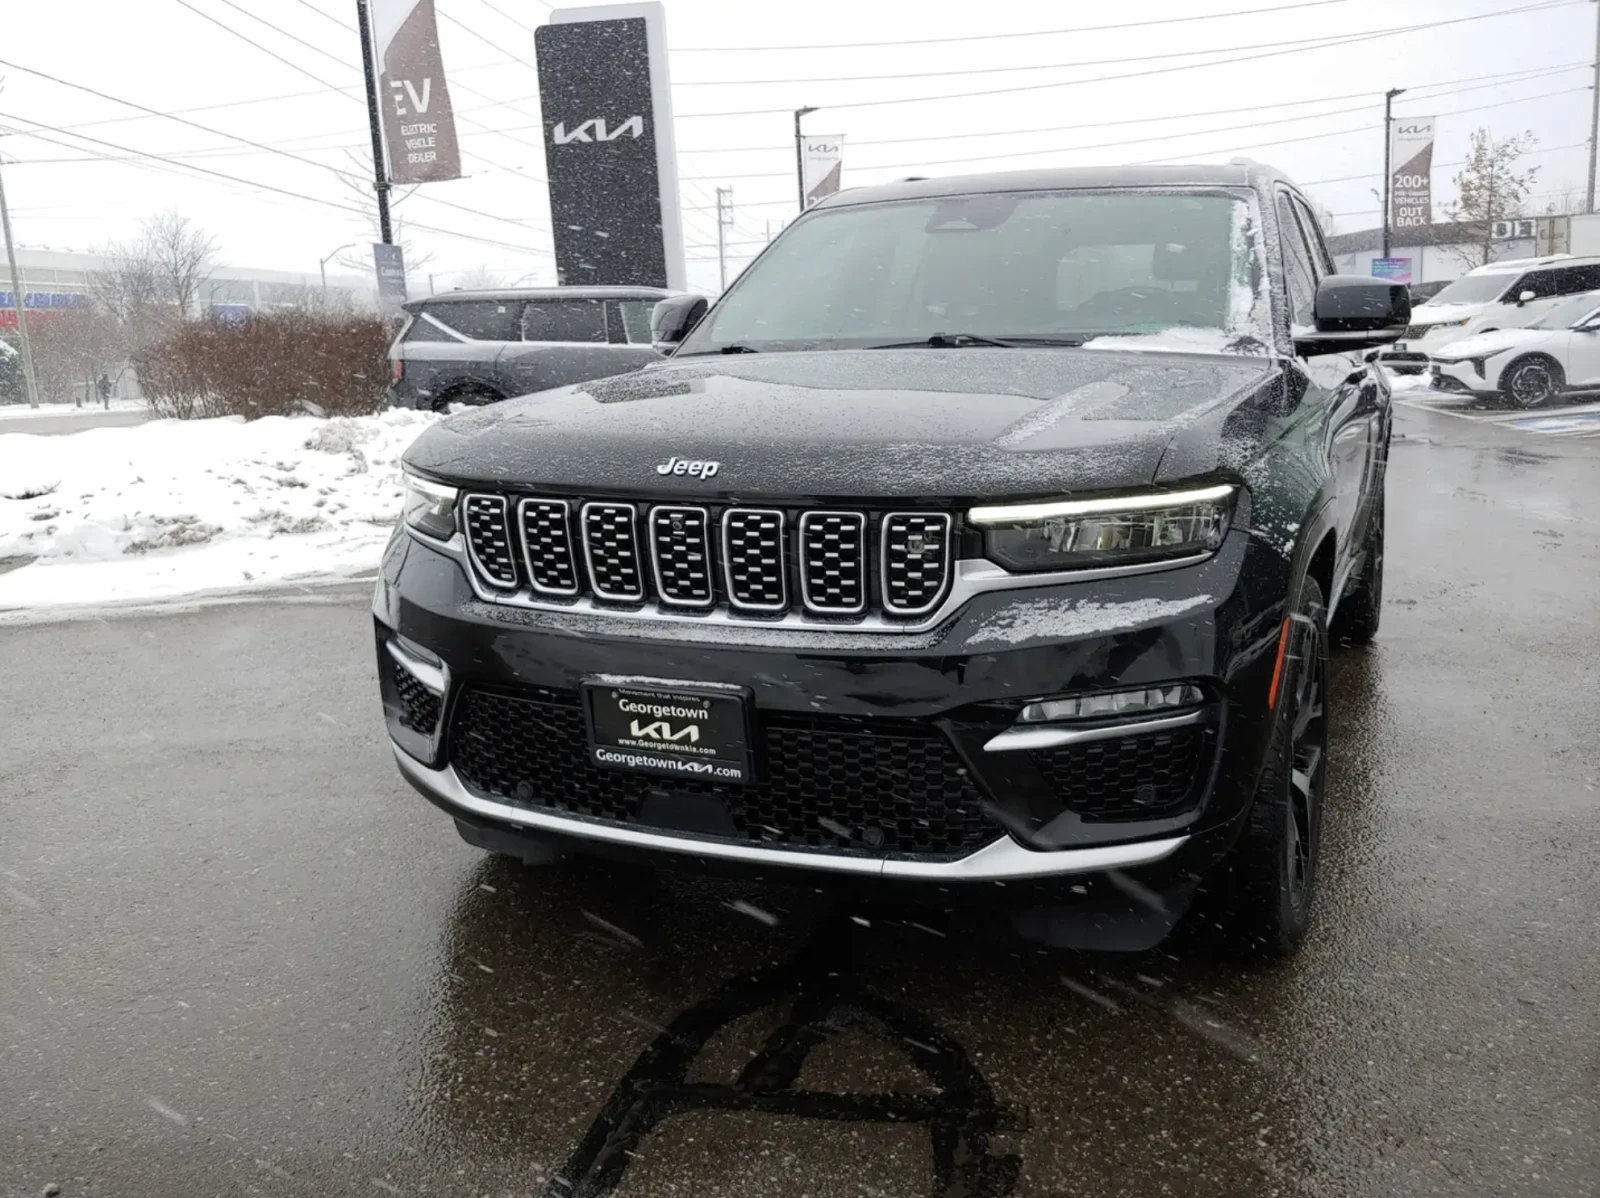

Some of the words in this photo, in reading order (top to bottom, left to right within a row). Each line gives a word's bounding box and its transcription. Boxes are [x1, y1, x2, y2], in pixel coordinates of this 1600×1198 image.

[390, 77, 431, 115] EV
[553, 115, 644, 144] KIA
[1398, 125, 1431, 134] KIA
[1394, 174, 1429, 188] 200+
[1400, 206, 1424, 217] OUT
[1396, 216, 1427, 227] BACK
[656, 456, 721, 480] Jeep
[656, 692, 671, 700] that
[618, 698, 709, 720] Georgetown
[630, 719, 700, 743] KIA
